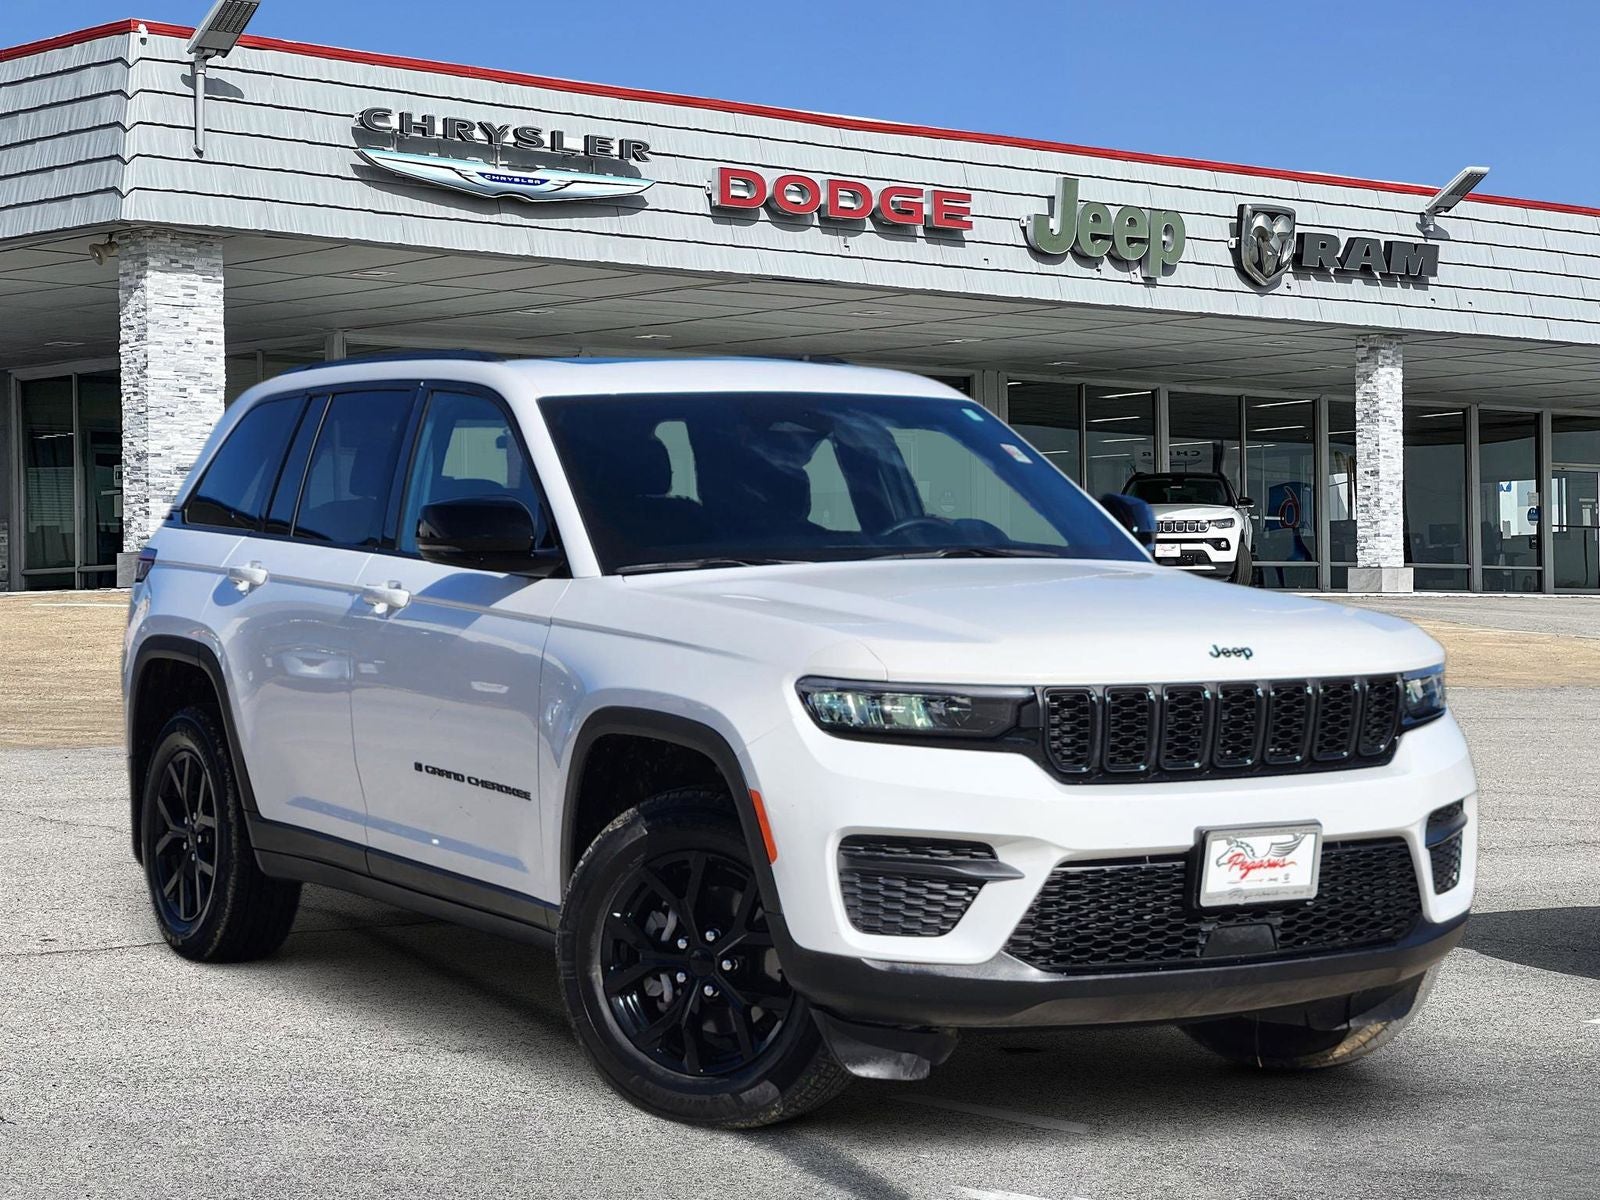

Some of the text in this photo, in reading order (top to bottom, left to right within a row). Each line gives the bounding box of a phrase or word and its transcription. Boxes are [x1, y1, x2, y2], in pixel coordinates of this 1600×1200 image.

[358, 106, 650, 163] CHRYSLER
[484, 174, 541, 185] CHRYSLER
[712, 166, 973, 230] DODGE
[1027, 177, 1185, 277] Jeep
[1297, 232, 1439, 277] RAM
[1208, 644, 1253, 660] Jeep
[424, 765, 532, 801] GRAND CHEROKEE
